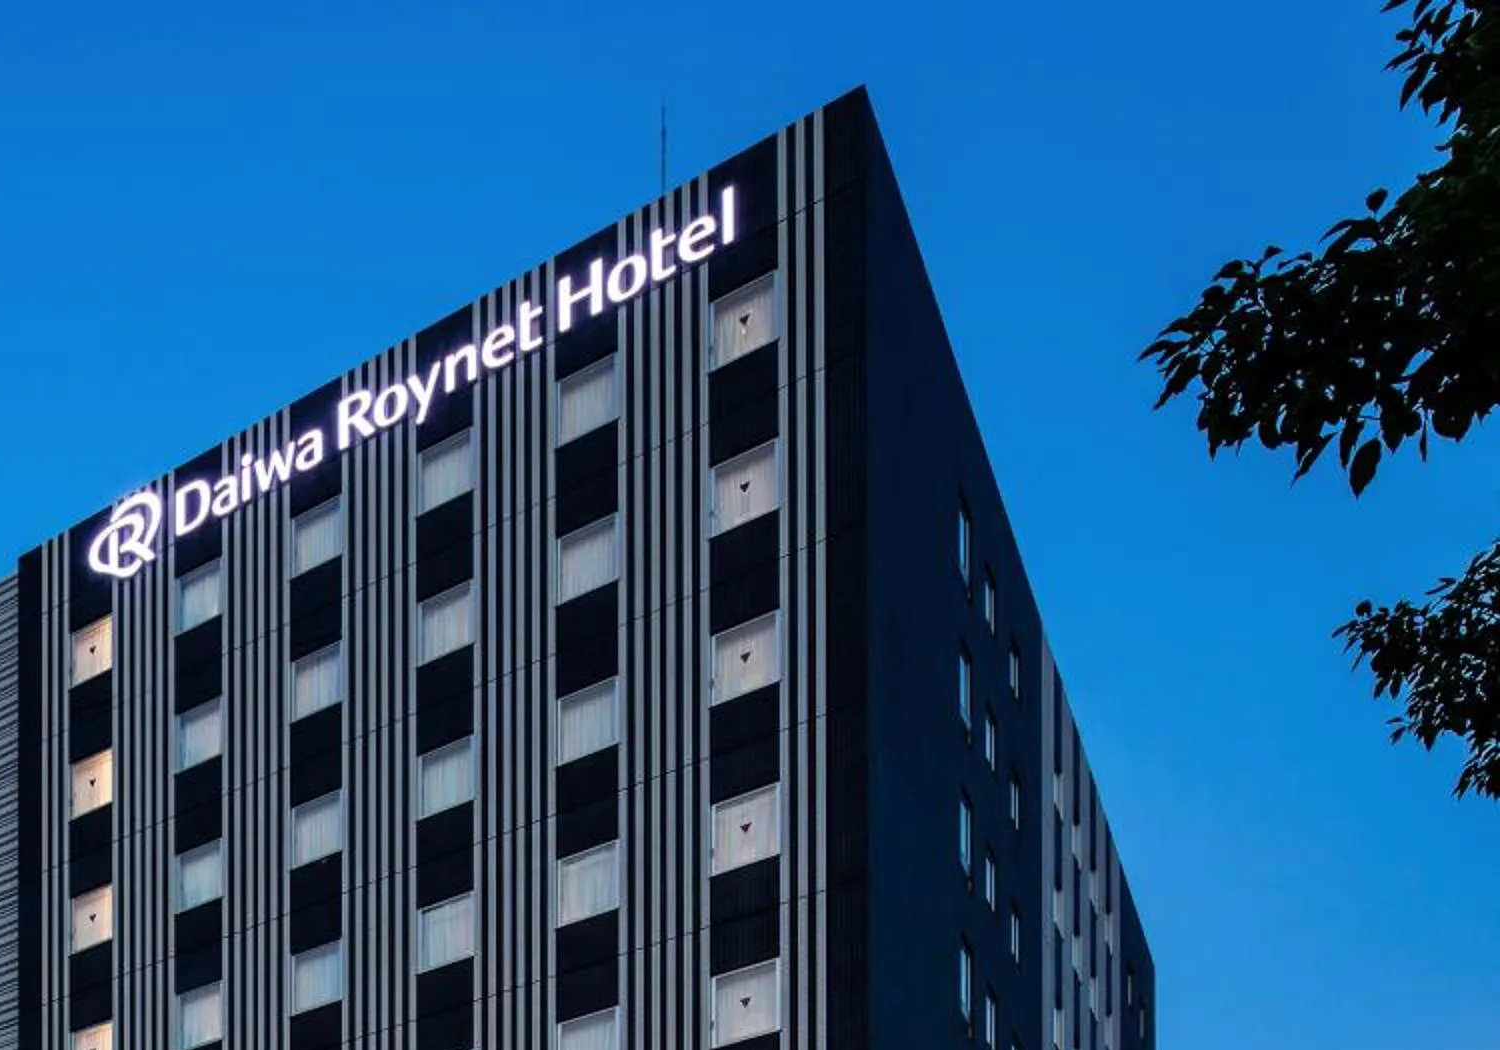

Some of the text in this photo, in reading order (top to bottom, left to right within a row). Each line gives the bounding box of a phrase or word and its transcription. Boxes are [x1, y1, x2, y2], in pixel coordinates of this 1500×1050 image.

[174, 426, 324, 538] Daiwa
[337, 299, 544, 451] Roynet
[557, 184, 736, 334] Hotel
